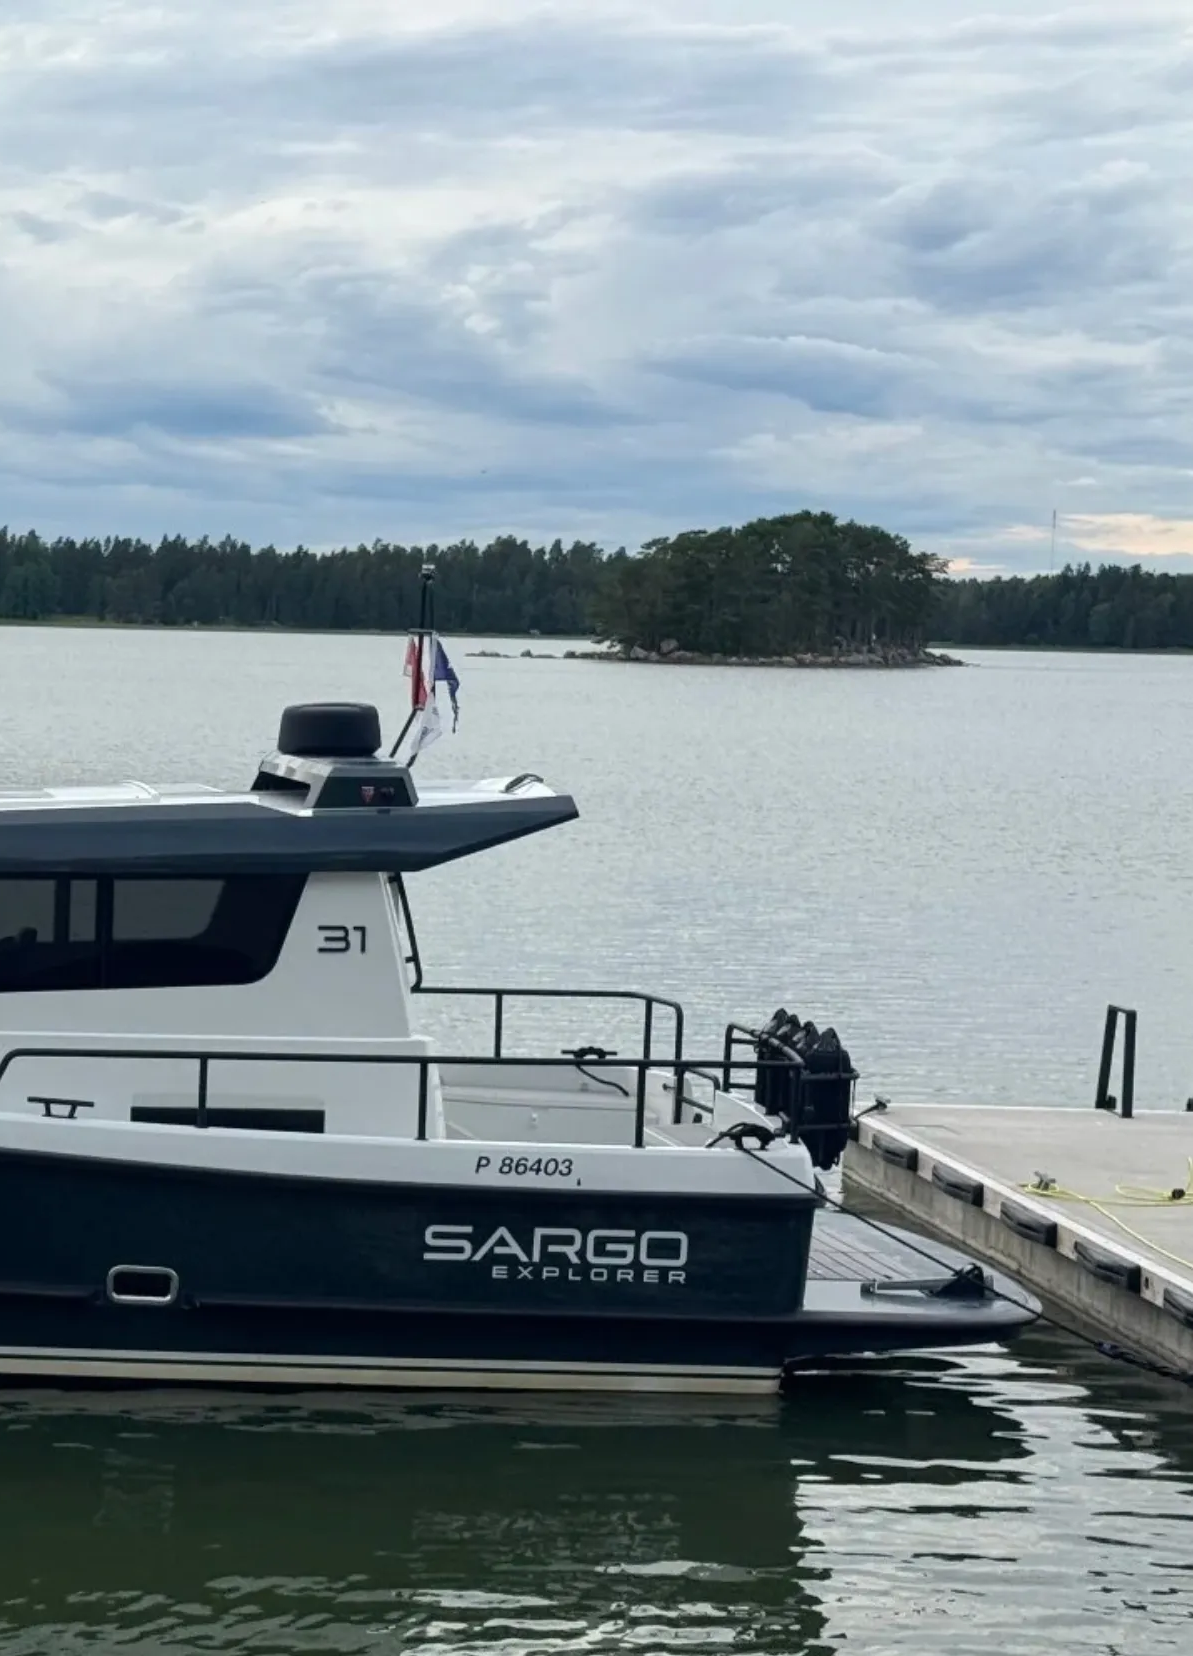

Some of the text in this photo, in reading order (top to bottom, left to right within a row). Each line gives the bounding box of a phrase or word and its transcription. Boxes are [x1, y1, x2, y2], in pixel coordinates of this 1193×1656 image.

[316, 925, 367, 954] 31
[474, 1155, 574, 1177] P 86403
[423, 1224, 689, 1267] SARGO
[491, 1265, 687, 1285] EXPLORER
